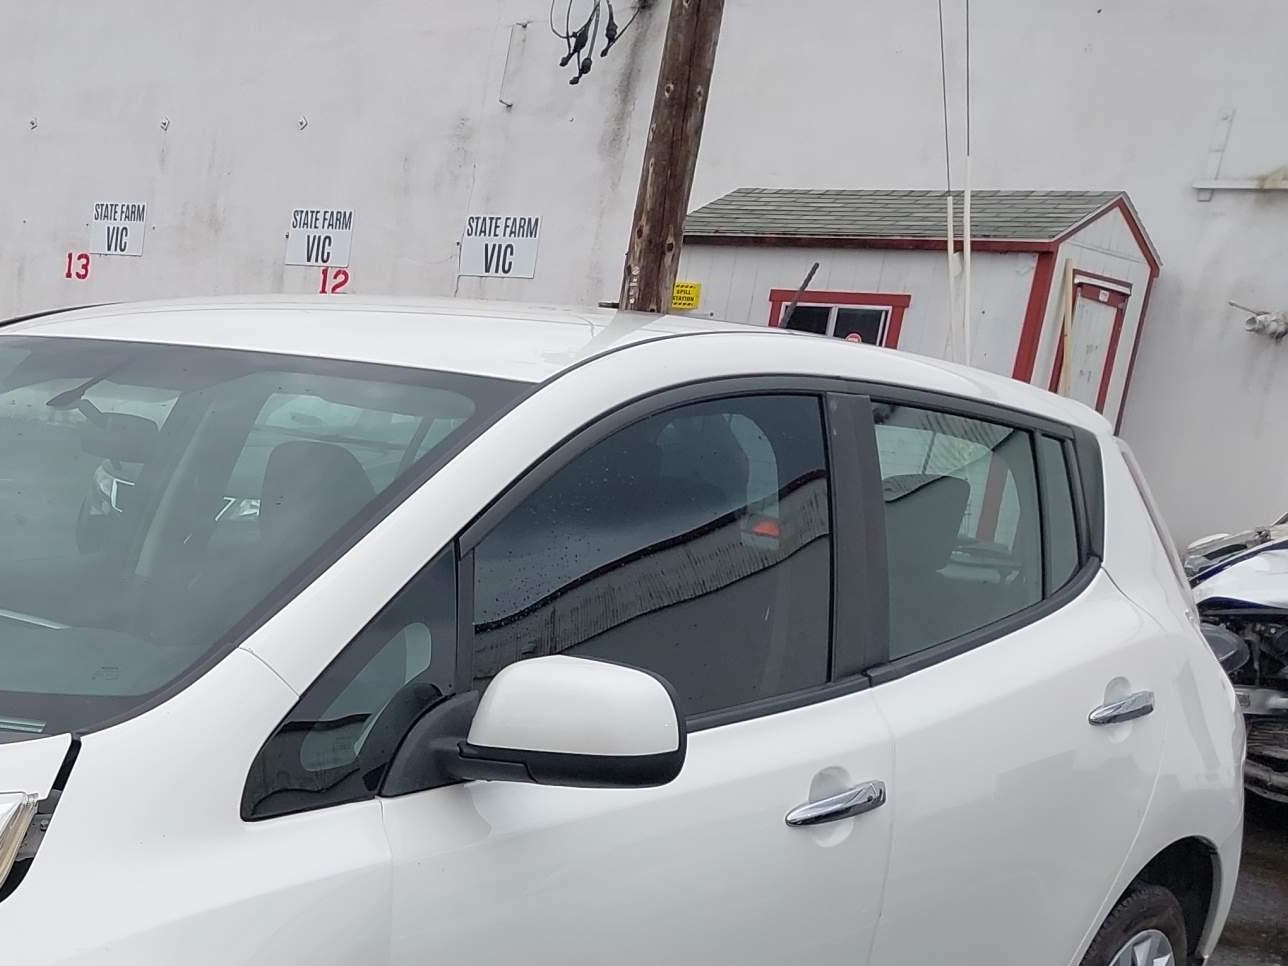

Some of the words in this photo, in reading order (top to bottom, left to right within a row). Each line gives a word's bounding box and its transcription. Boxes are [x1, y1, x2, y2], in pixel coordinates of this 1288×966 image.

[94, 203, 119, 221] STATE
[120, 204, 145, 222] FARM
[292, 210, 320, 229] STATE
[322, 211, 352, 230] FARM
[107, 226, 128, 252] VIC
[467, 216, 500, 237] STATE
[502, 217, 539, 238] FARM
[306, 235, 332, 263] VIC
[484, 243, 513, 274] VIC
[65, 253, 90, 279] 13
[319, 268, 349, 294] 12
